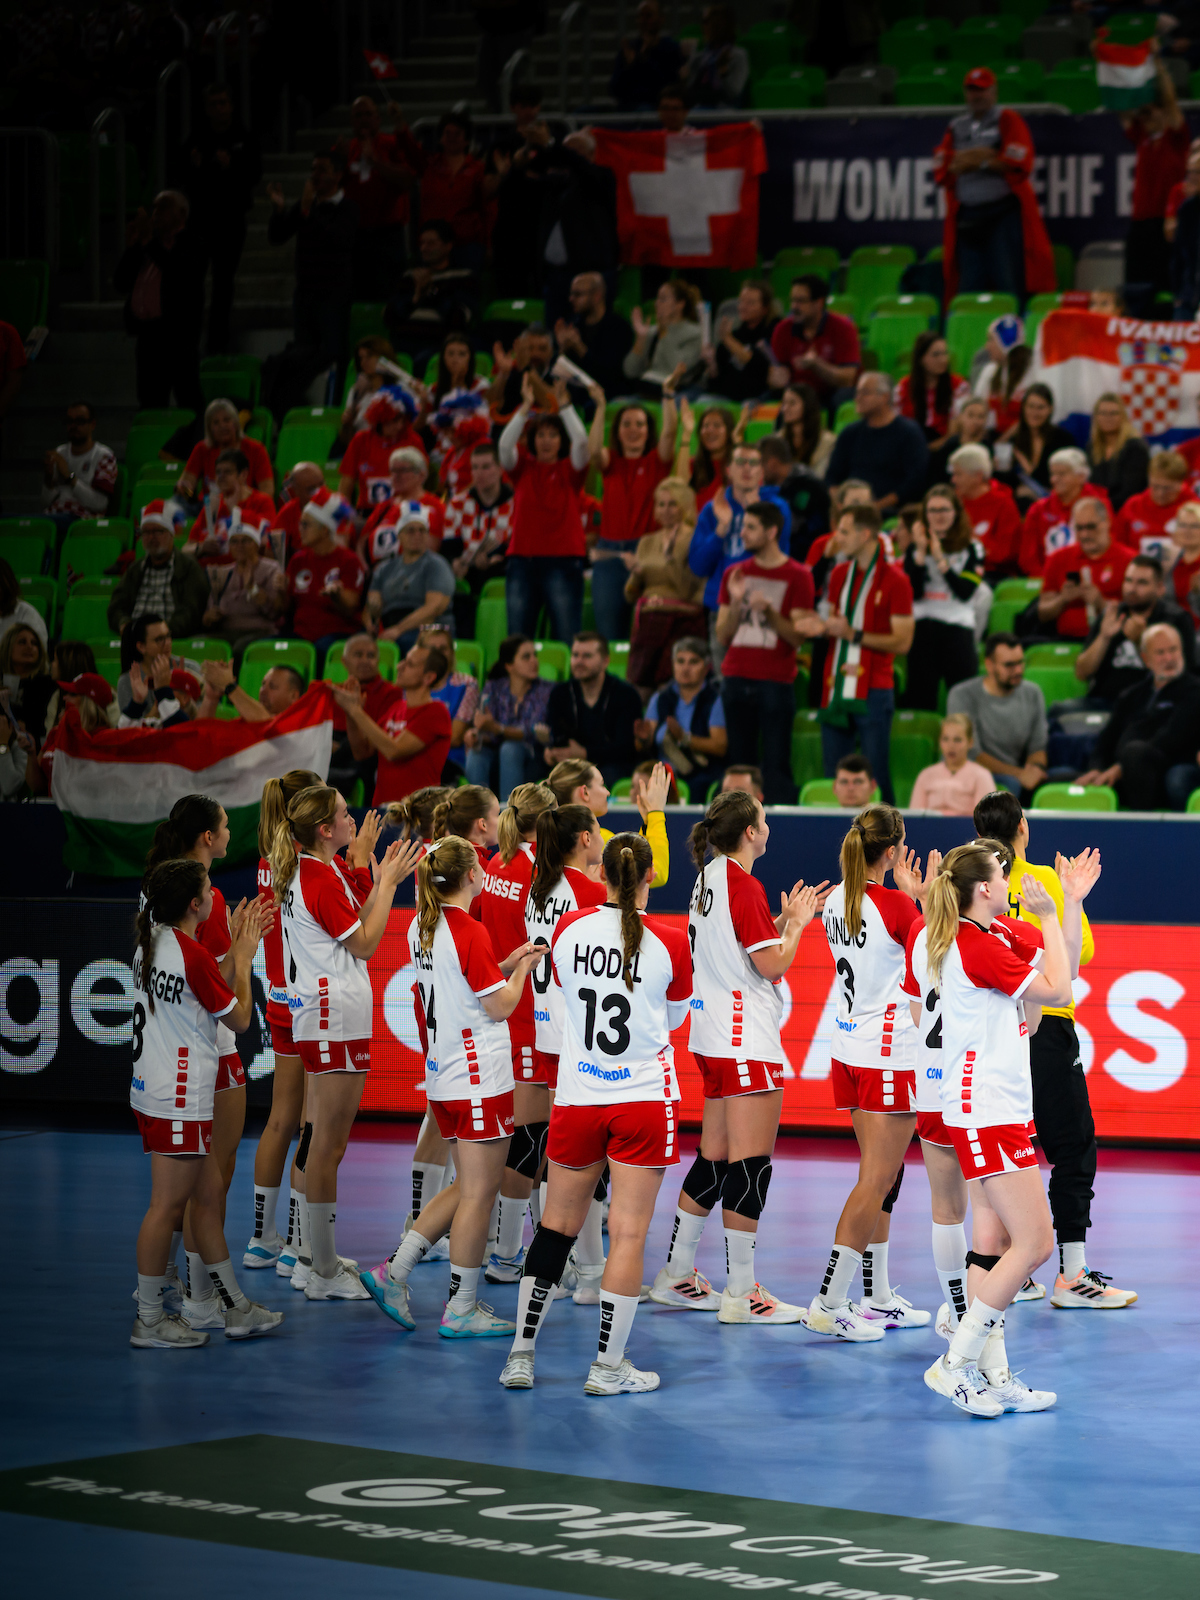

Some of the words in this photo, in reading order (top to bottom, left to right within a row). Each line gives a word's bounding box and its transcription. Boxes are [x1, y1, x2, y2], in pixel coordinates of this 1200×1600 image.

[578, 988, 631, 1055] 13
[837, 957, 855, 1014] 3
[26, 1476, 124, 1495] The
[120, 1490, 261, 1515] team
[256, 1511, 343, 1523] of
[315, 1519, 568, 1555] regional
[548, 1548, 797, 1590] banking
[478, 1503, 746, 1538] otp
[729, 1535, 1059, 1584] Group
